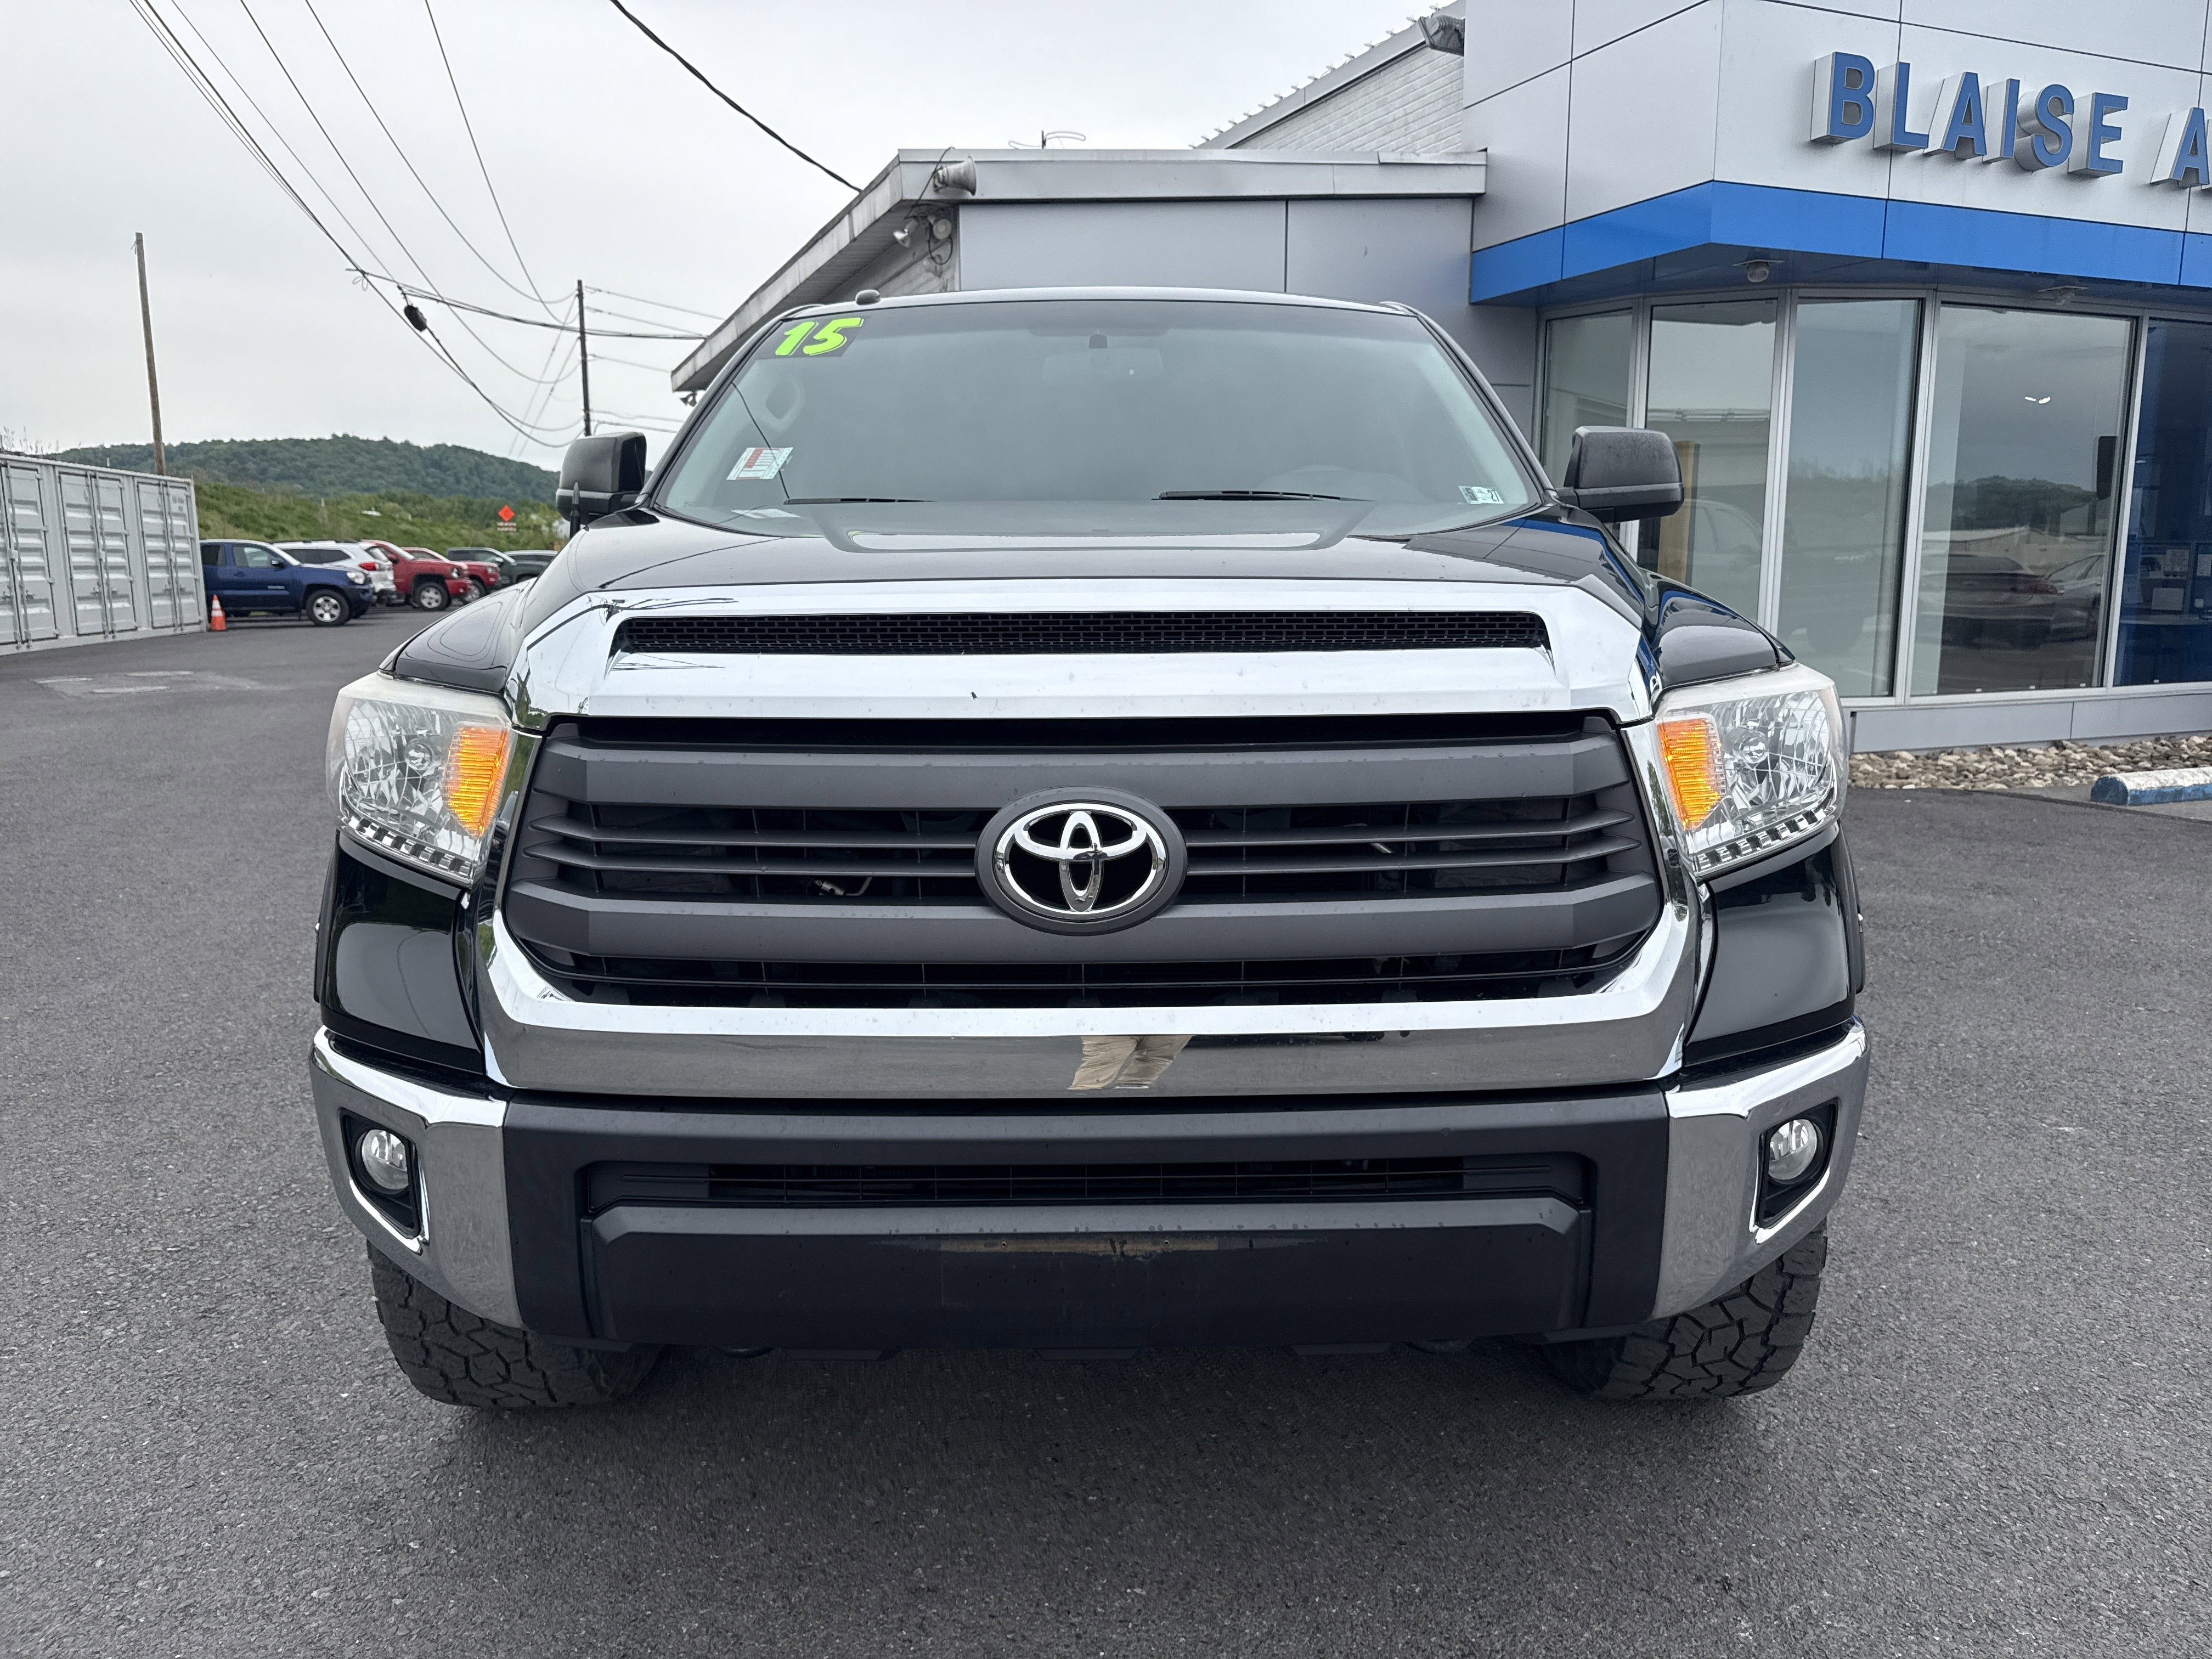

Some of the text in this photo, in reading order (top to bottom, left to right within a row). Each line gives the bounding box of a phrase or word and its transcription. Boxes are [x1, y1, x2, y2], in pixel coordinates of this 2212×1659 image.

[1812, 52, 2212, 188] BLAISE A
[775, 317, 864, 356] 15
